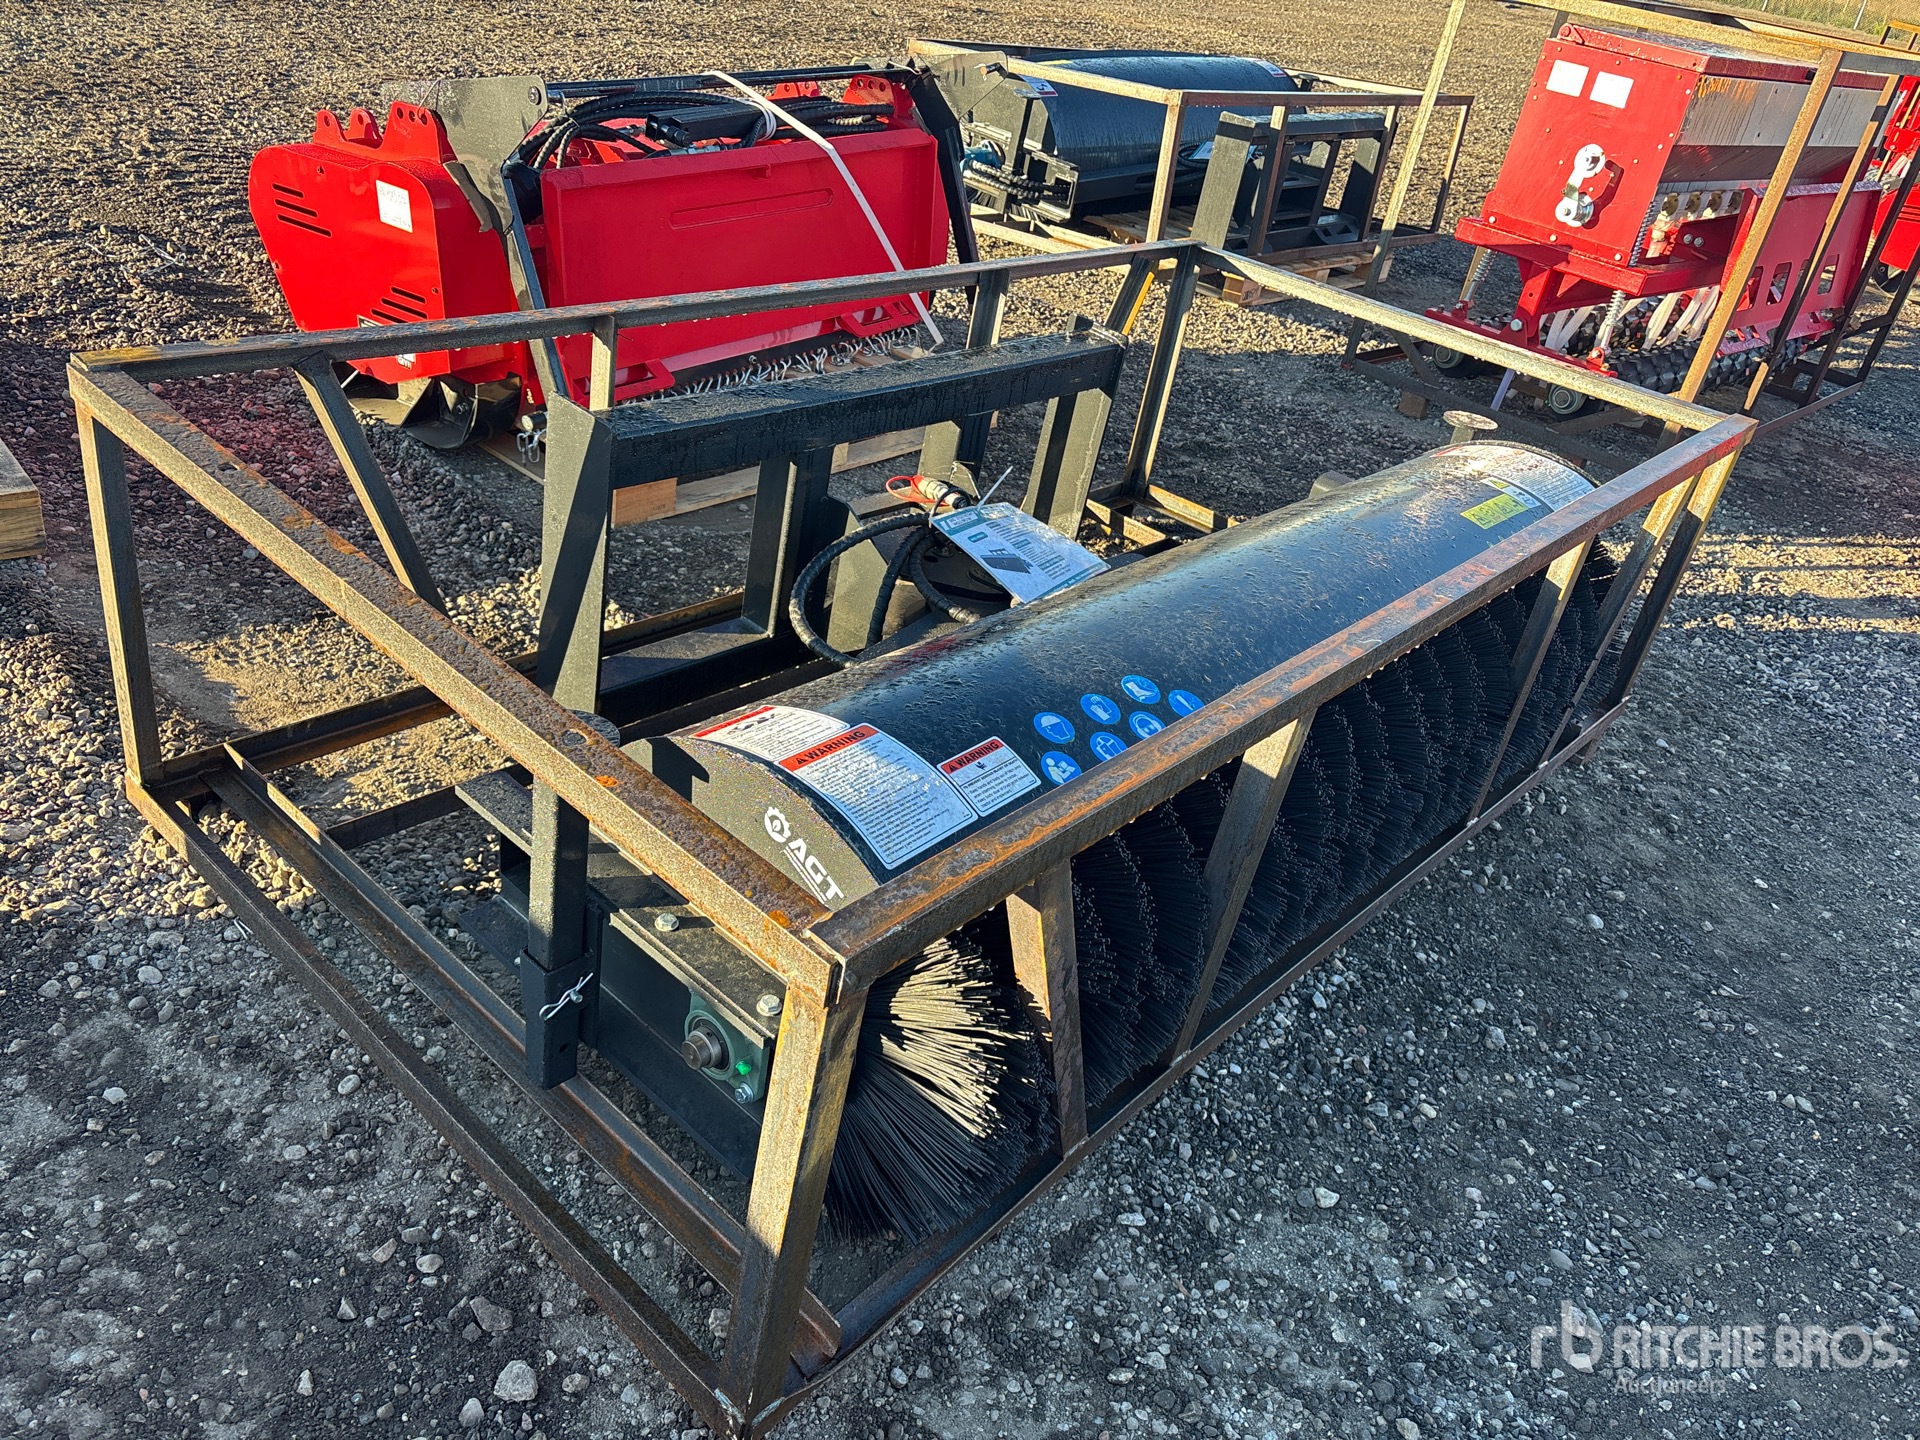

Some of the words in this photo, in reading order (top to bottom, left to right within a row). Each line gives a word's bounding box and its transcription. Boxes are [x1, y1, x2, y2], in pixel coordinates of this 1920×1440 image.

[805, 731, 866, 760] WARNING
[955, 741, 999, 767] WARNING
[787, 838, 845, 900] AGT
